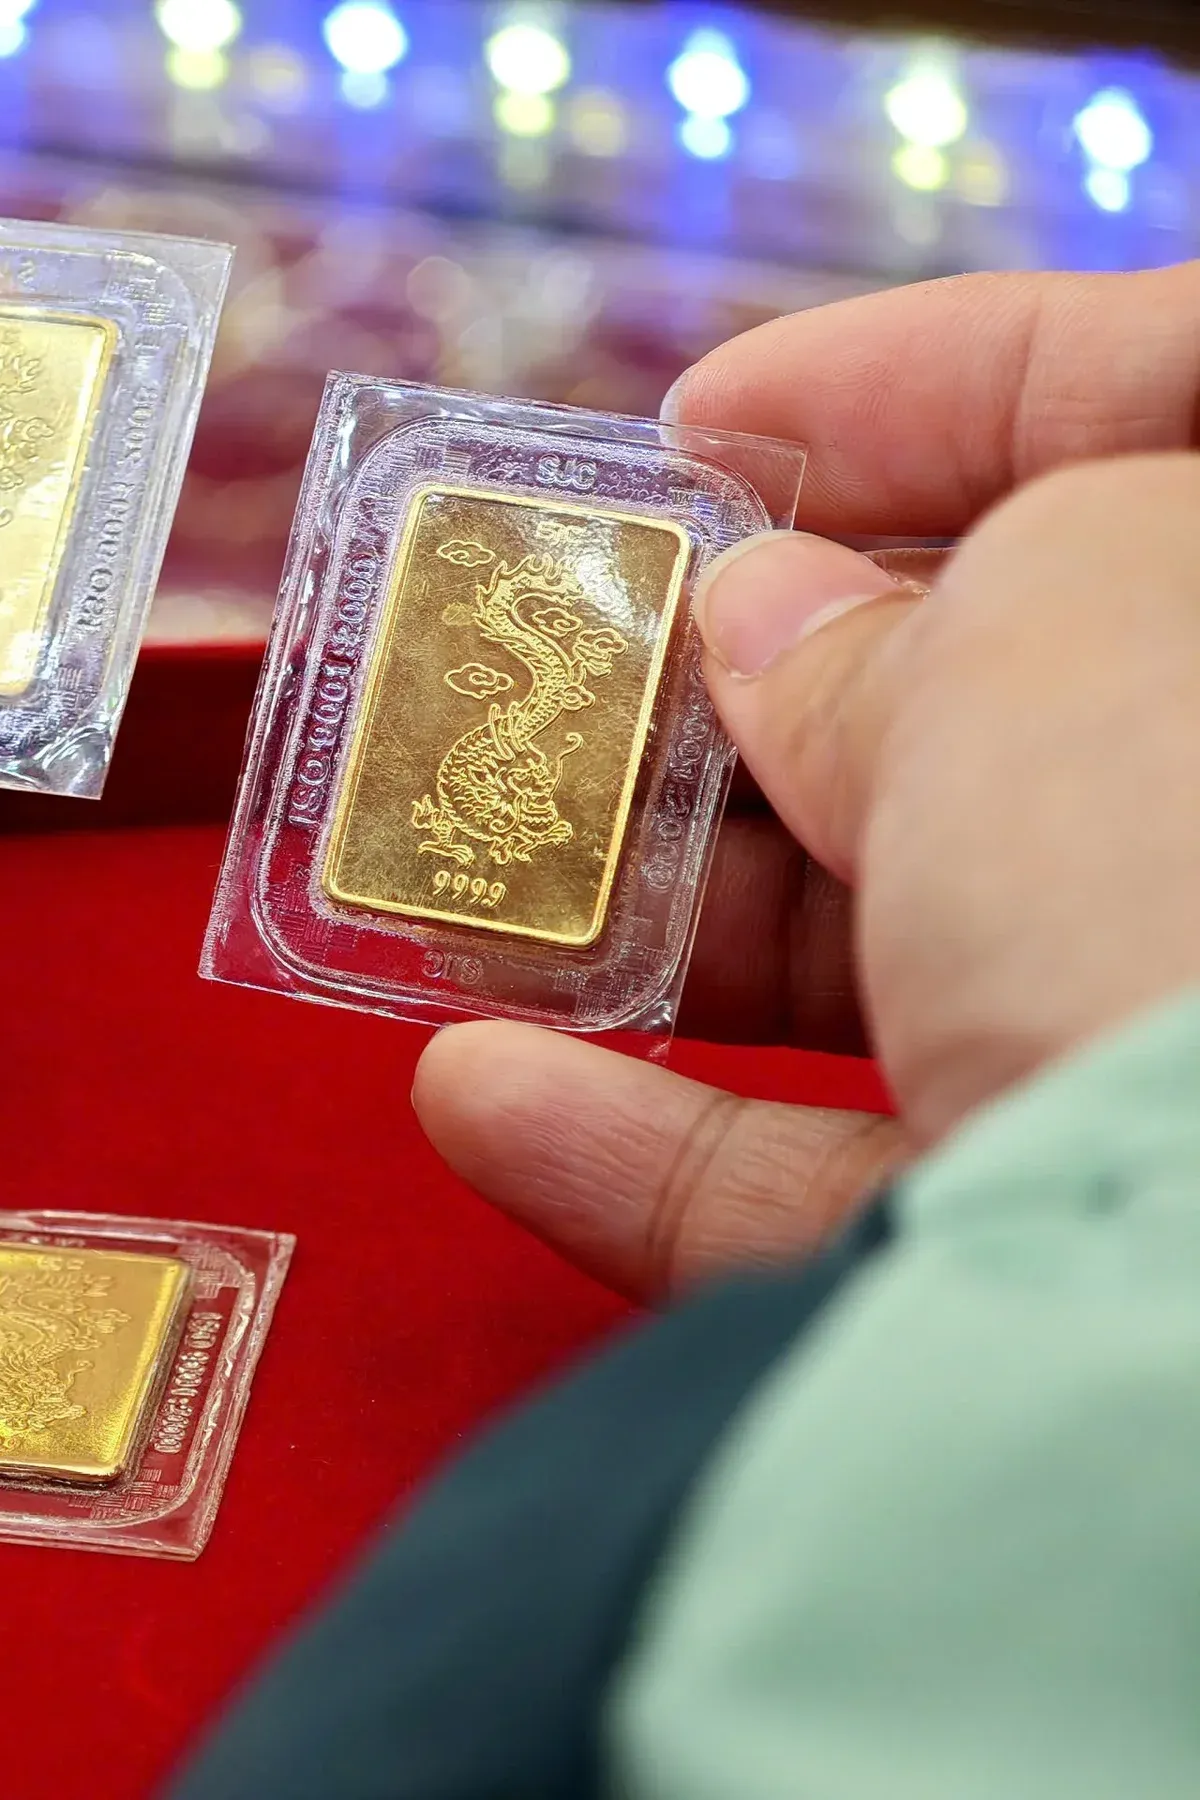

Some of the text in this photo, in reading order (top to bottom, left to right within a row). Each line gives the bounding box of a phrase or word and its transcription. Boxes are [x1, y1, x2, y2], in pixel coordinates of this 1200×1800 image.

[536, 453, 598, 490] SJC
[288, 747, 332, 824] ISO
[421, 947, 484, 986] SJC
[184, 1311, 224, 1349] ISO
